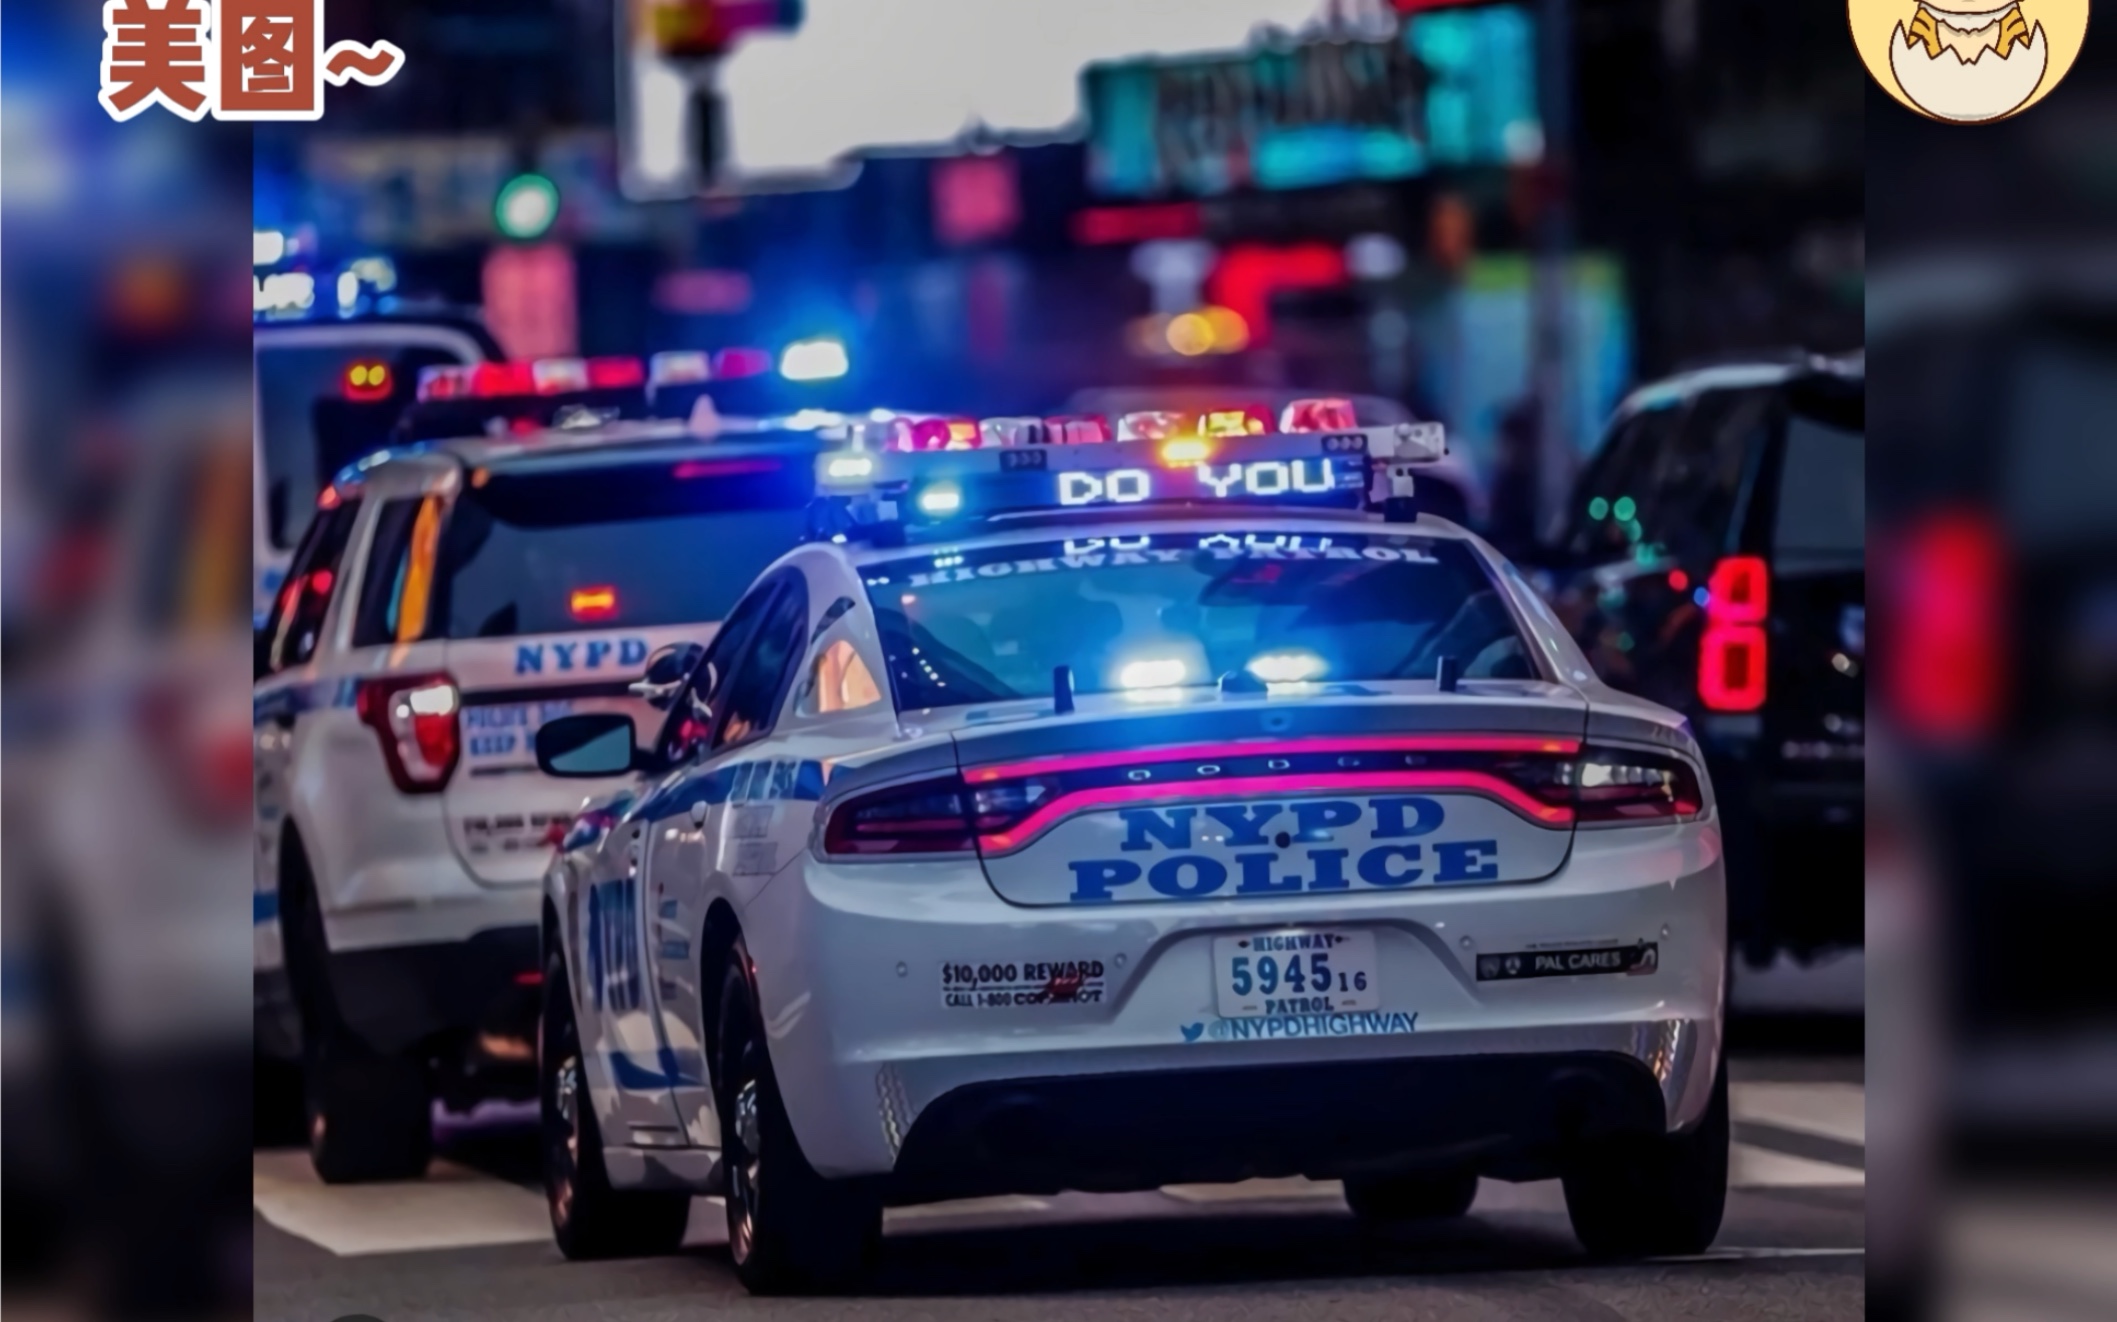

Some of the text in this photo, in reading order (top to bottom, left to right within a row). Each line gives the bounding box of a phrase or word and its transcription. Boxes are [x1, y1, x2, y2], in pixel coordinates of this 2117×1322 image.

[1058, 457, 1335, 506] DO YOU
[515, 638, 648, 675] NYPD
[1119, 795, 1446, 852] NYPD
[1067, 839, 1500, 902] POLICE
[1252, 933, 1336, 952] HIGHWAY
[942, 960, 1105, 991] $10,000 REWARD
[1231, 952, 1378, 997] 5945 16
[1534, 951, 1622, 971] PAL CARES
[945, 992, 974, 1008] CALL
[1264, 996, 1335, 1015] PATROL
[1207, 1011, 1419, 1041] @NYPDHIGHWAY
